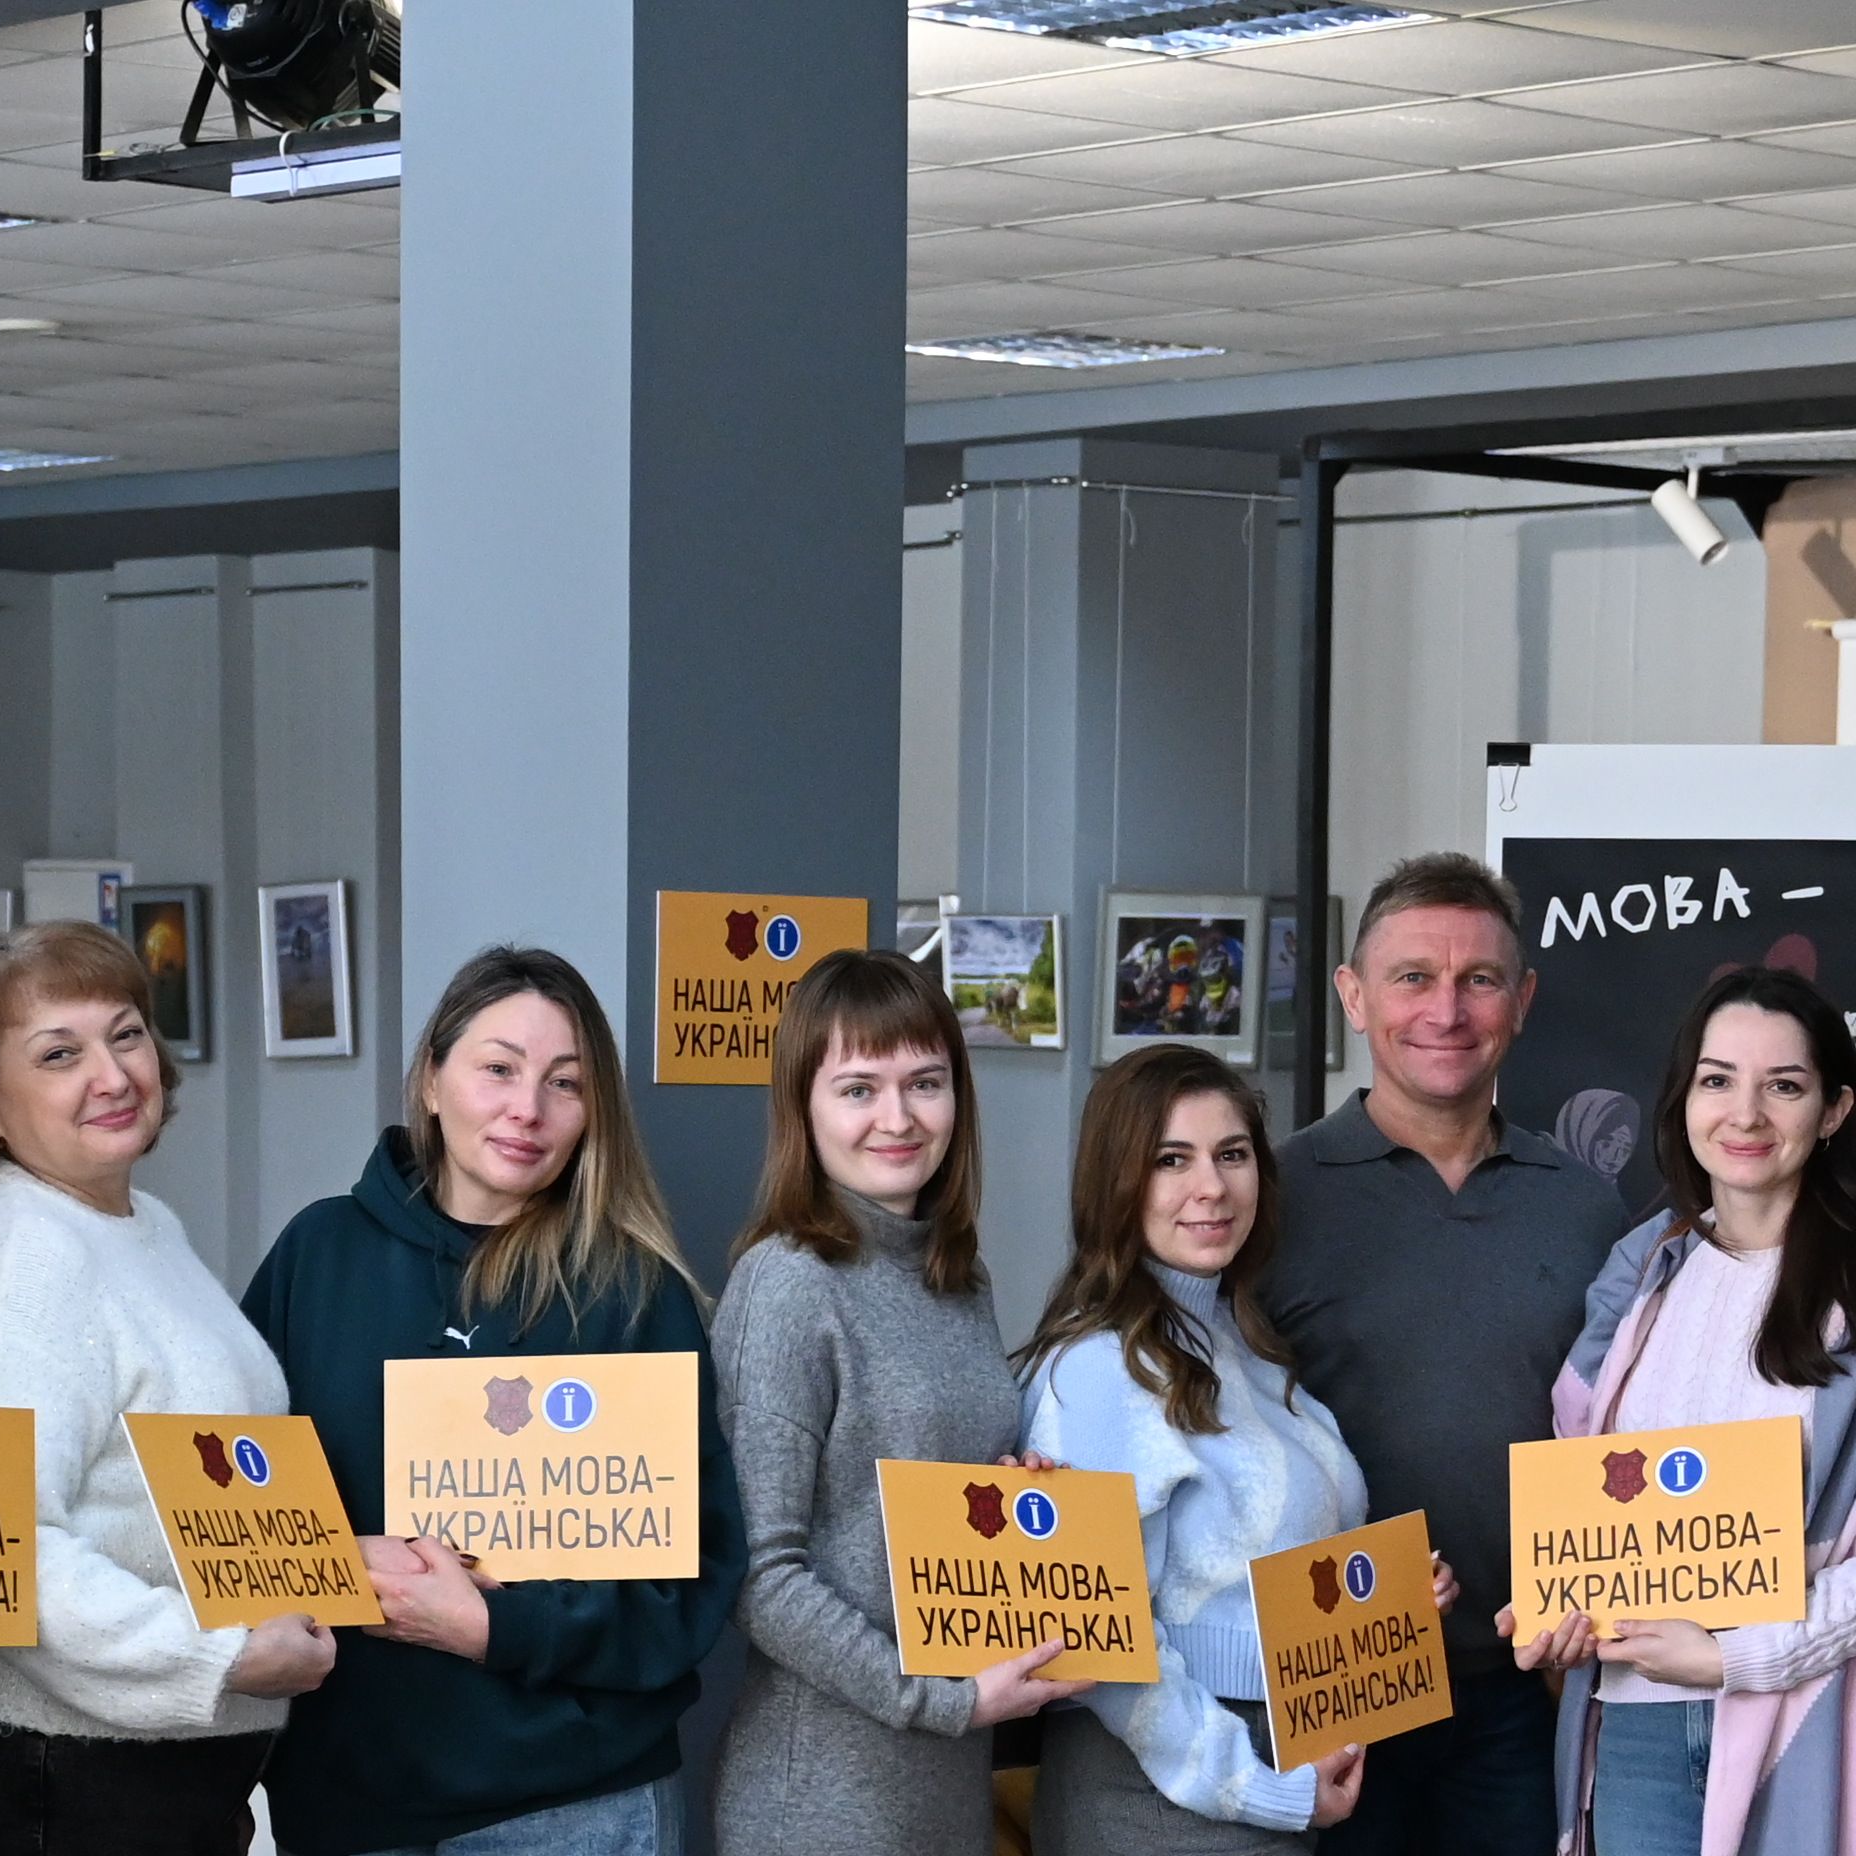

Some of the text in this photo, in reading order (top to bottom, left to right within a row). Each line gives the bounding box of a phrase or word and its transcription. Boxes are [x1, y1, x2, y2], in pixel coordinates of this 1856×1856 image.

[1540, 867, 1751, 949] МОВА
[673, 978, 754, 1013] НАША
[408, 1457, 527, 1499] НАША
[172, 1509, 256, 1548] НАША
[411, 1499, 673, 1551] УКРАЇНСЬКА!
[1532, 1523, 1643, 1567] НАША
[191, 1549, 360, 1599] УКРАЇНСЬКА!
[910, 1556, 1012, 1598] НАША
[1535, 1556, 1780, 1616] УКРАЇНСЬКА!
[916, 1601, 1136, 1653] УКРАЇНСЬКА!
[1276, 1633, 1348, 1689] НАША
[1284, 1654, 1436, 1739] УКРАЇНСЬКА!
